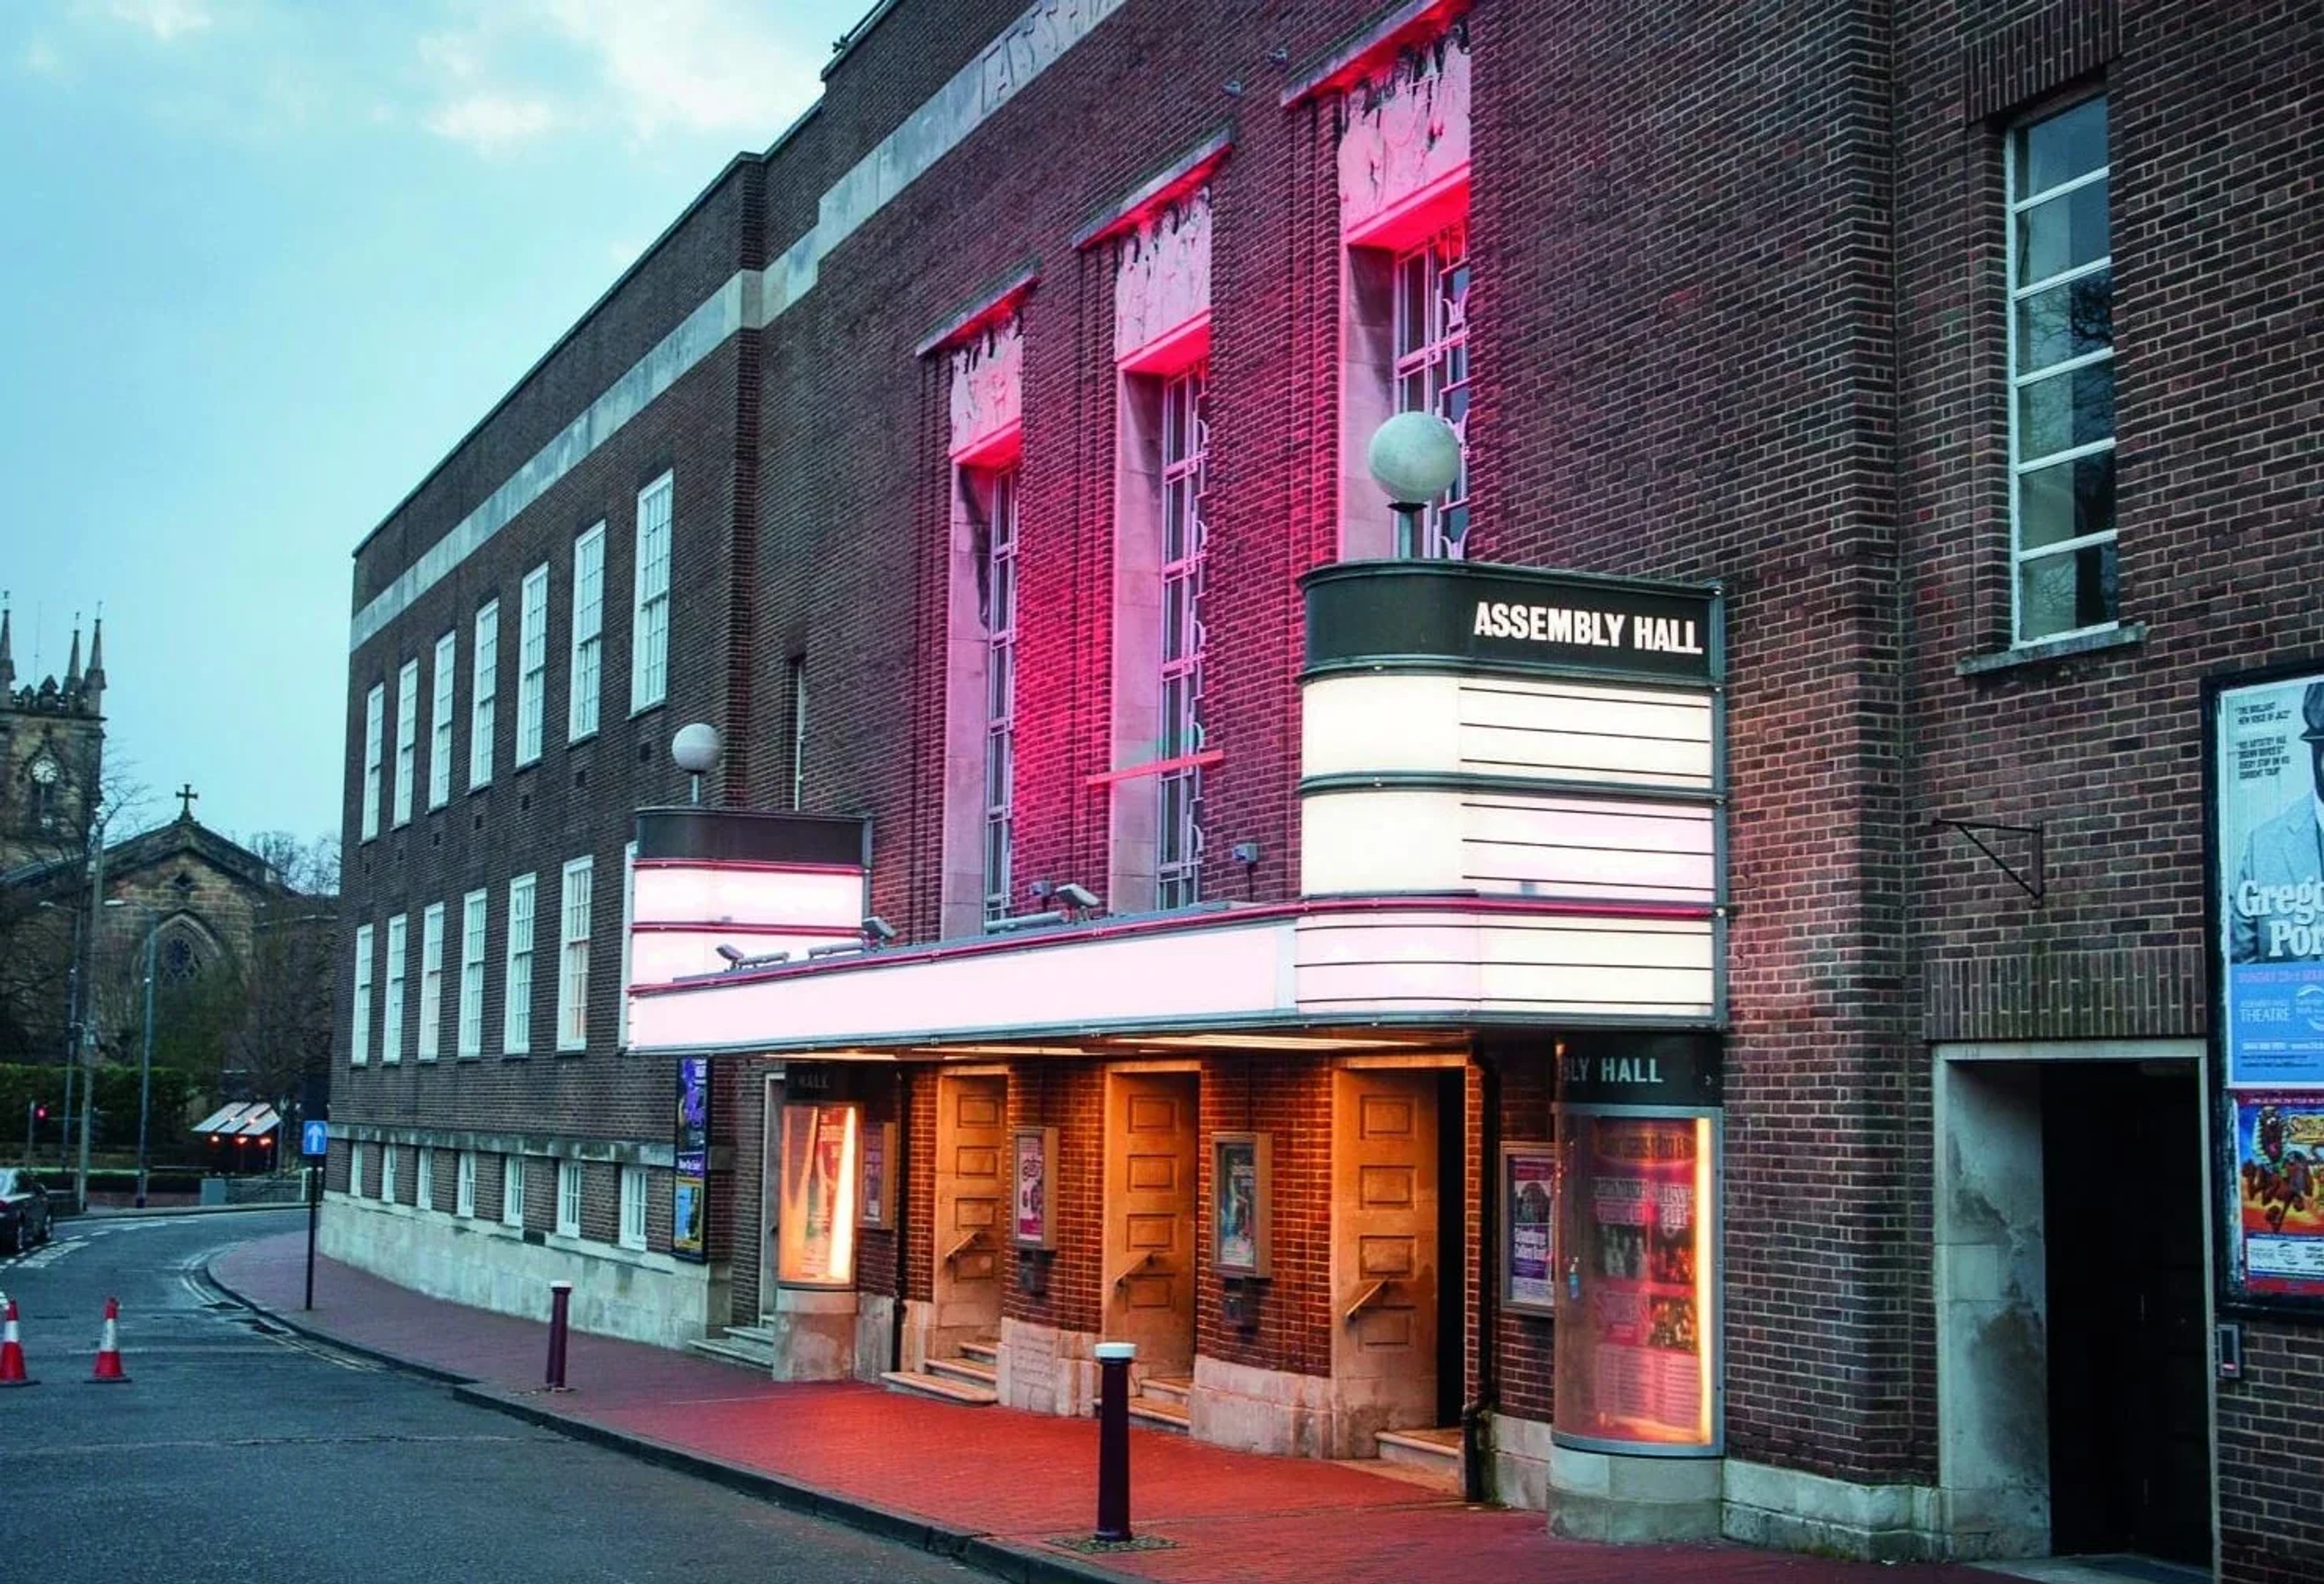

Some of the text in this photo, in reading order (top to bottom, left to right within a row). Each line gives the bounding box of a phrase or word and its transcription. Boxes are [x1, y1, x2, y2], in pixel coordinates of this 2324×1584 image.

[1474, 602, 1702, 654] ASSEMBLY HALL
[2240, 1007, 2289, 1022] THEATRE
[1600, 1057, 1665, 1082] HALL
